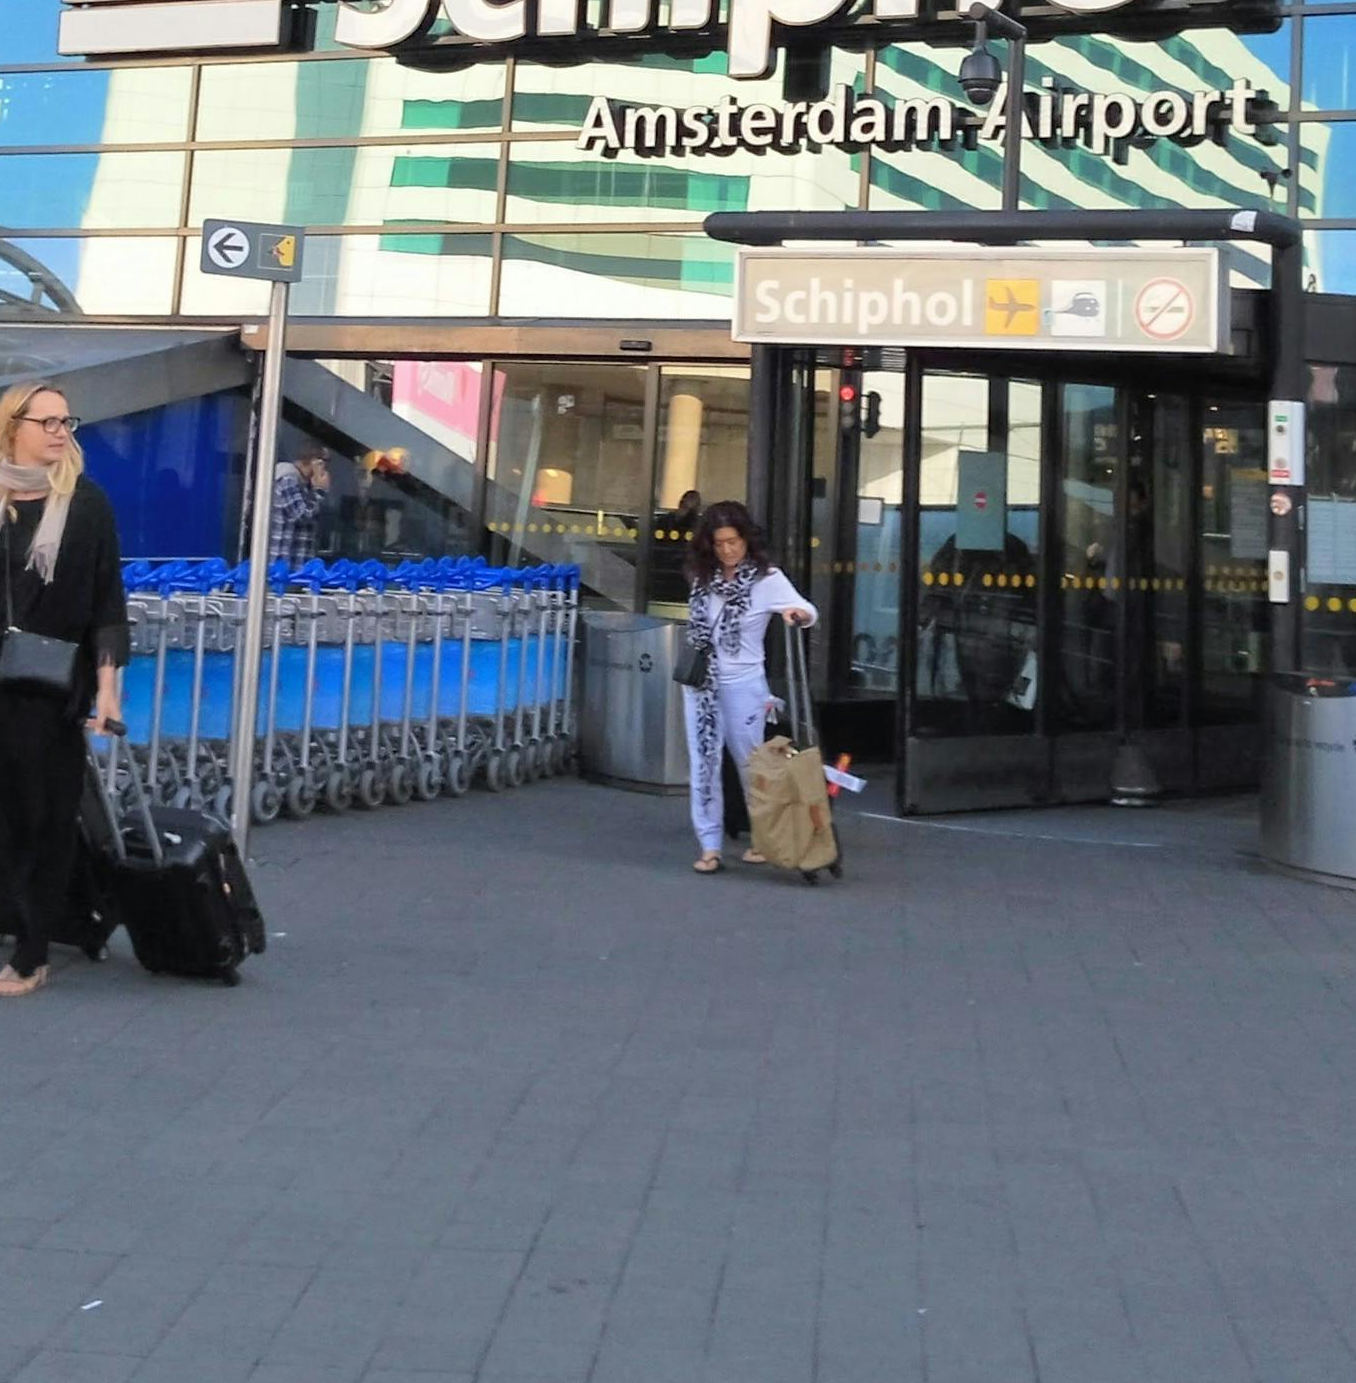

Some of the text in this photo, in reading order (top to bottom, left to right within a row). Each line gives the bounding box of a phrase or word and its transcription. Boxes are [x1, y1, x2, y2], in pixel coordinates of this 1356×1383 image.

[574, 75, 1257, 155] Amsterdam Airport
[755, 277, 974, 335] Schiphol
